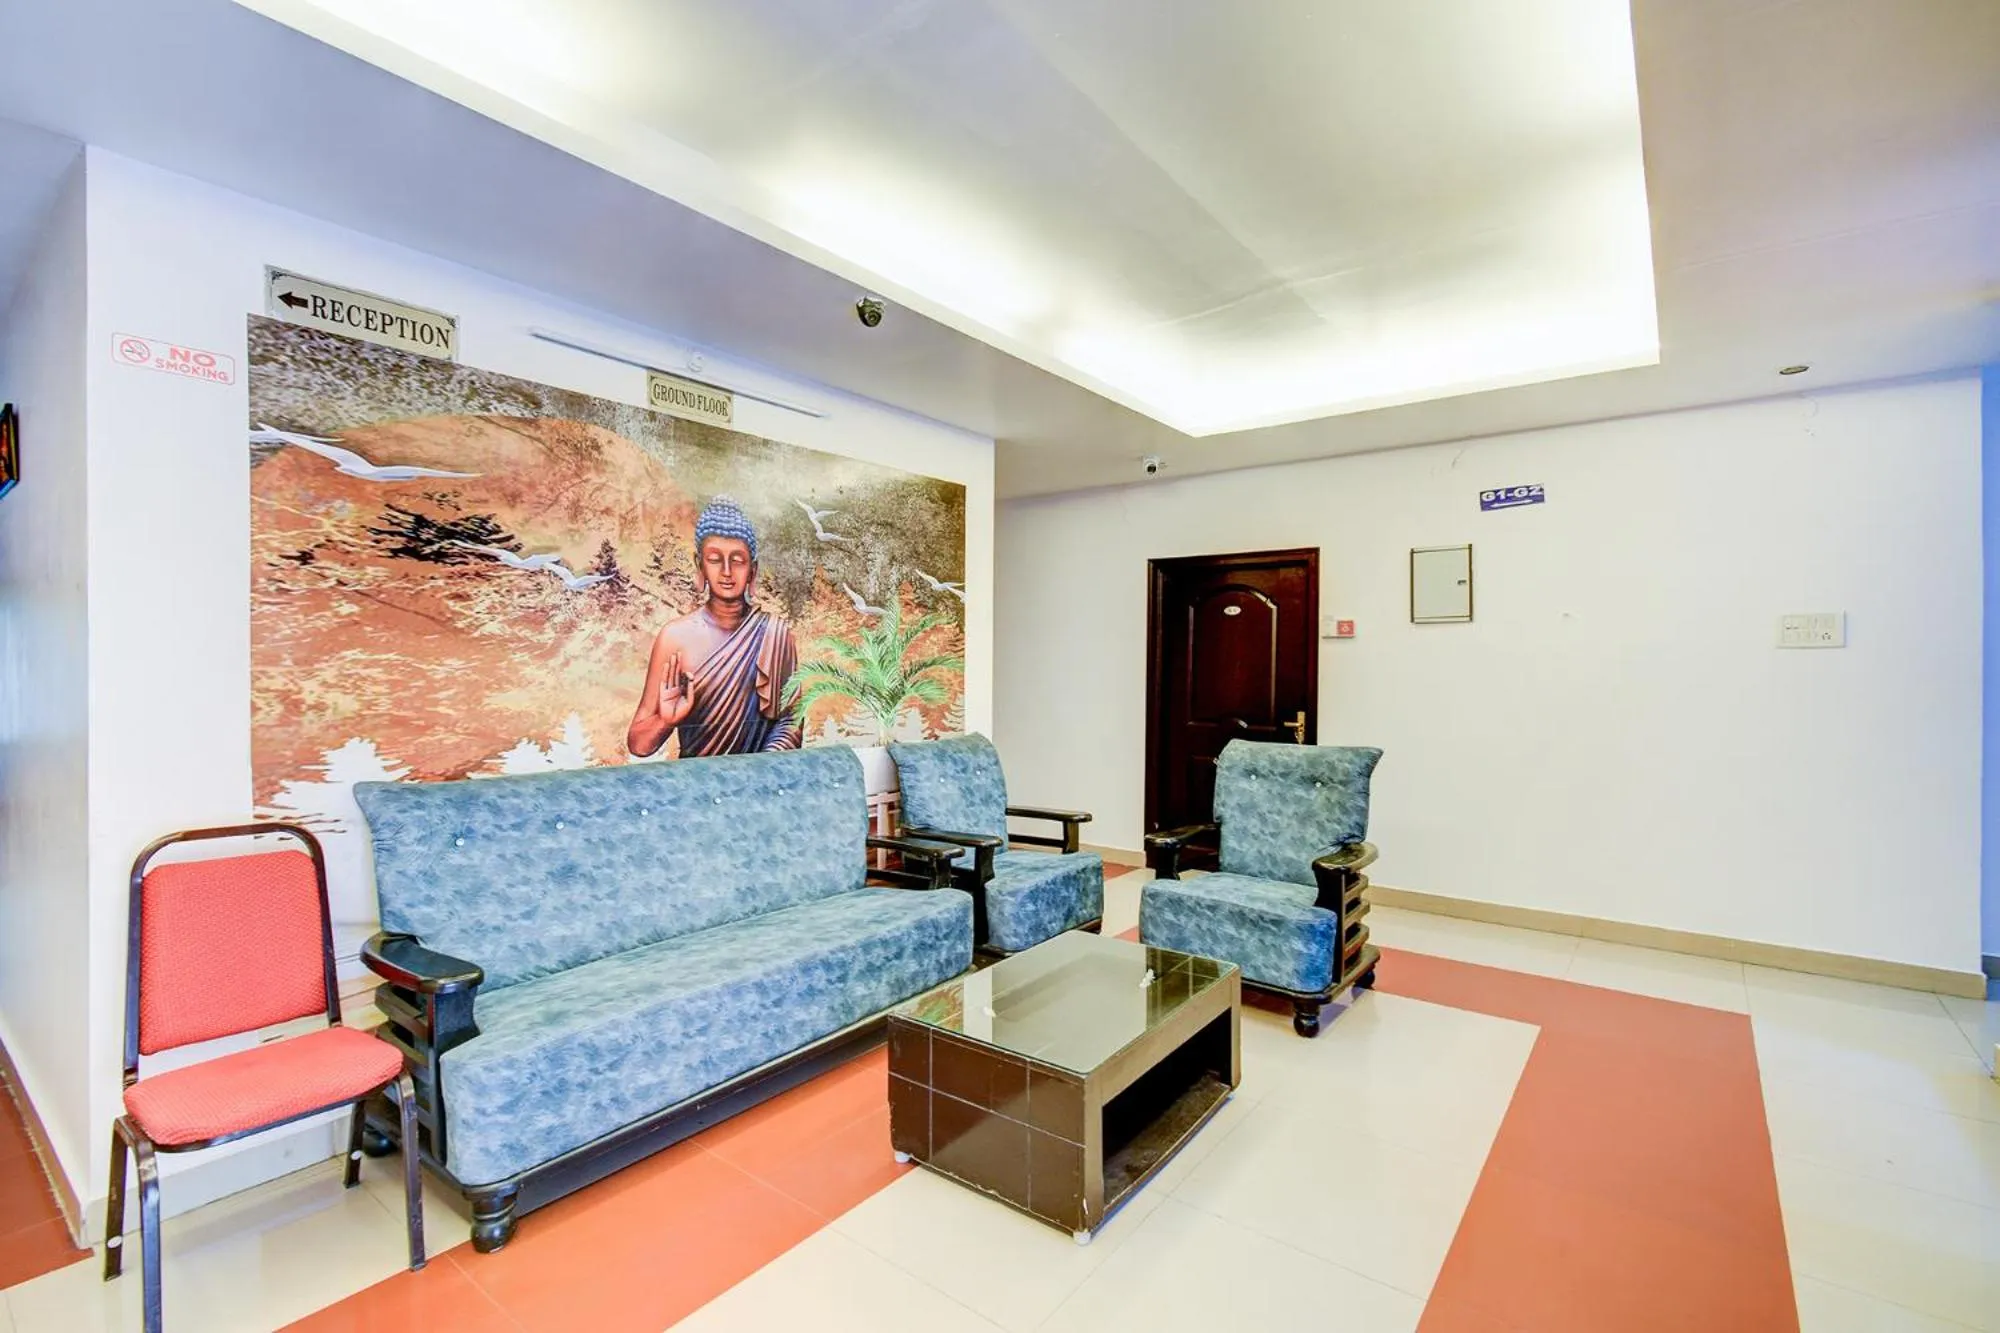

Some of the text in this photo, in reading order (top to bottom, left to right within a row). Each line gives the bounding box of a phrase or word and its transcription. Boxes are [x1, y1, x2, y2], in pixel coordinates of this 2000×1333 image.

[310, 294, 450, 349] RECEPTION
[169, 347, 216, 367] NO
[155, 358, 229, 381] SMOKING
[653, 383, 729, 416] GROUND FLOOR
[1481, 486, 1543, 502] G1-G2
